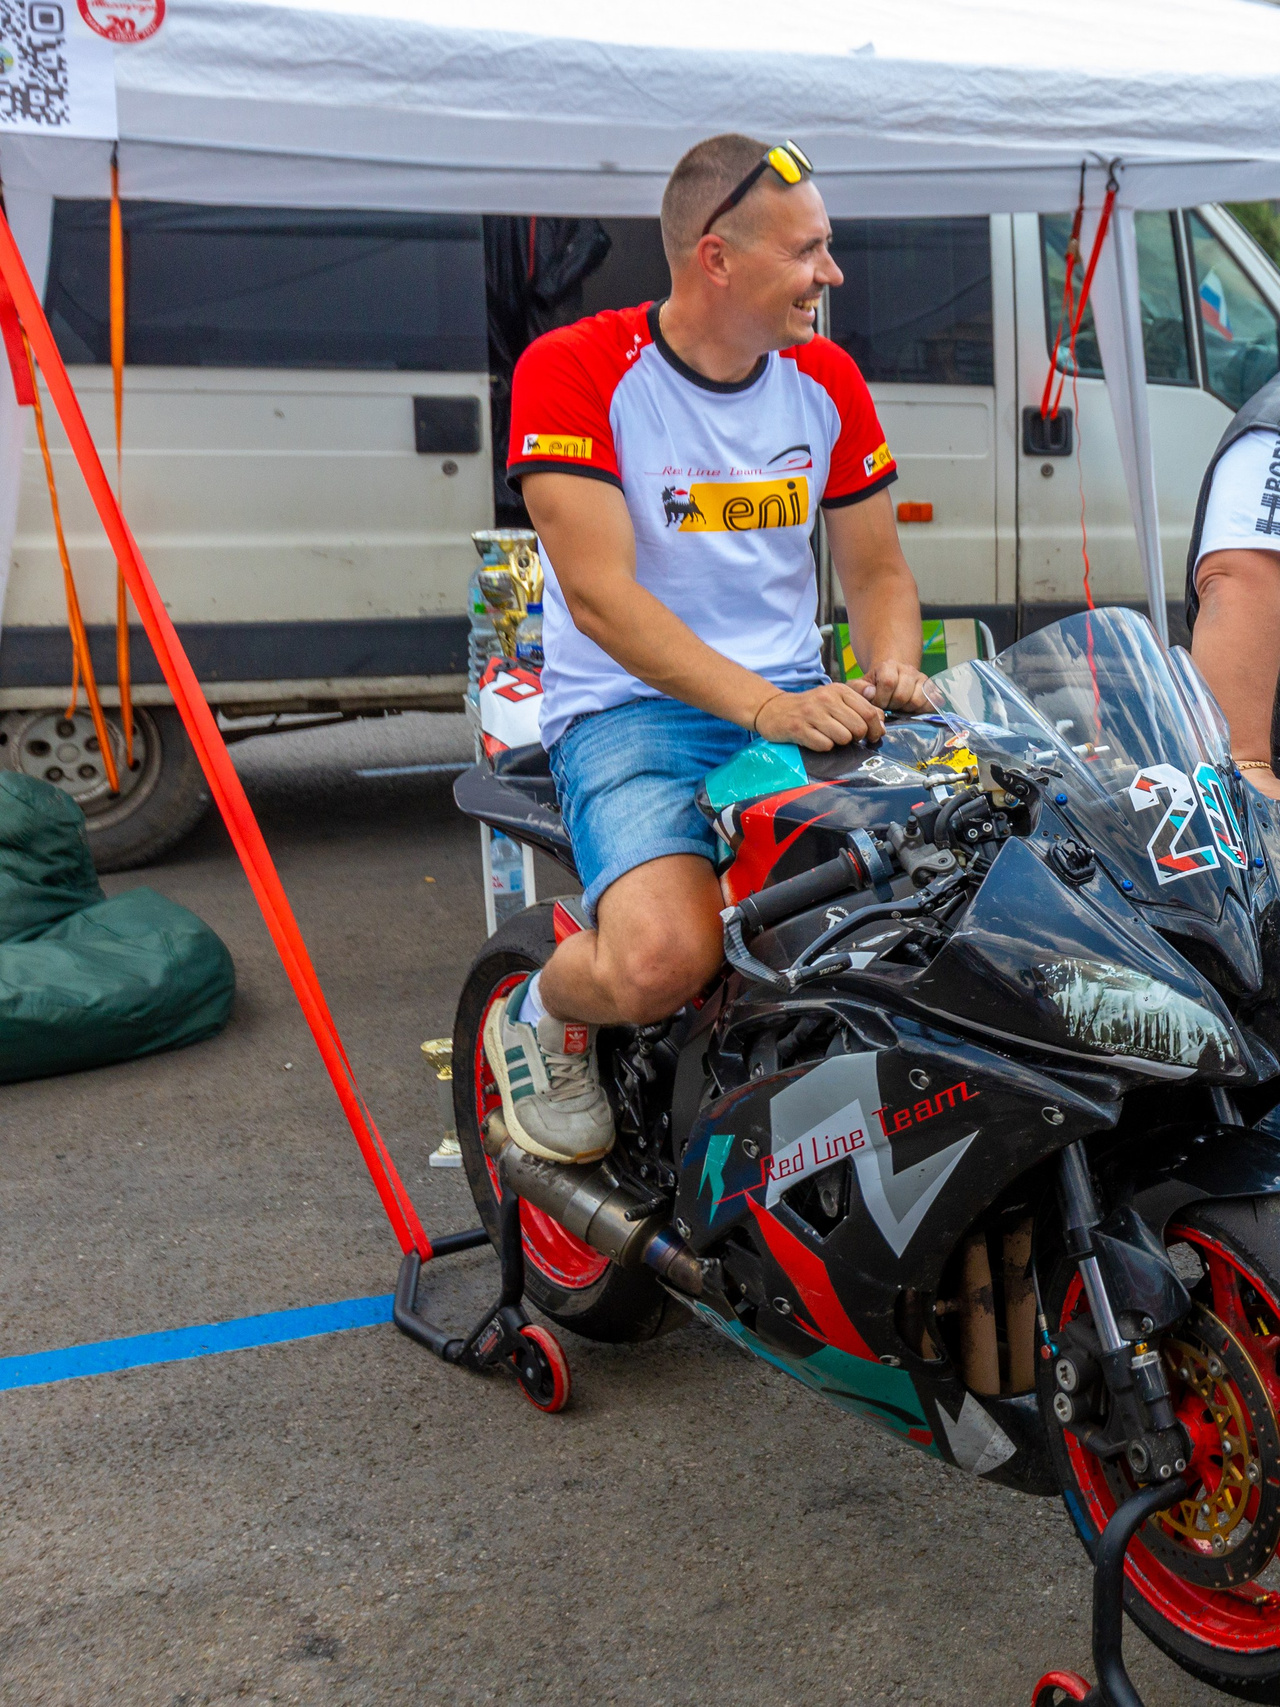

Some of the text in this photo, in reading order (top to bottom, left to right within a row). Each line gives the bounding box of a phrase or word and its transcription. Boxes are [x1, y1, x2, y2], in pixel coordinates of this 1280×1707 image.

[549, 439, 587, 459] eni
[687, 467, 721, 477] Line
[730, 466, 762, 477] Team
[722, 480, 801, 532] eni
[1128, 762, 1249, 886] 20
[760, 1081, 980, 1185] Red Line Team
